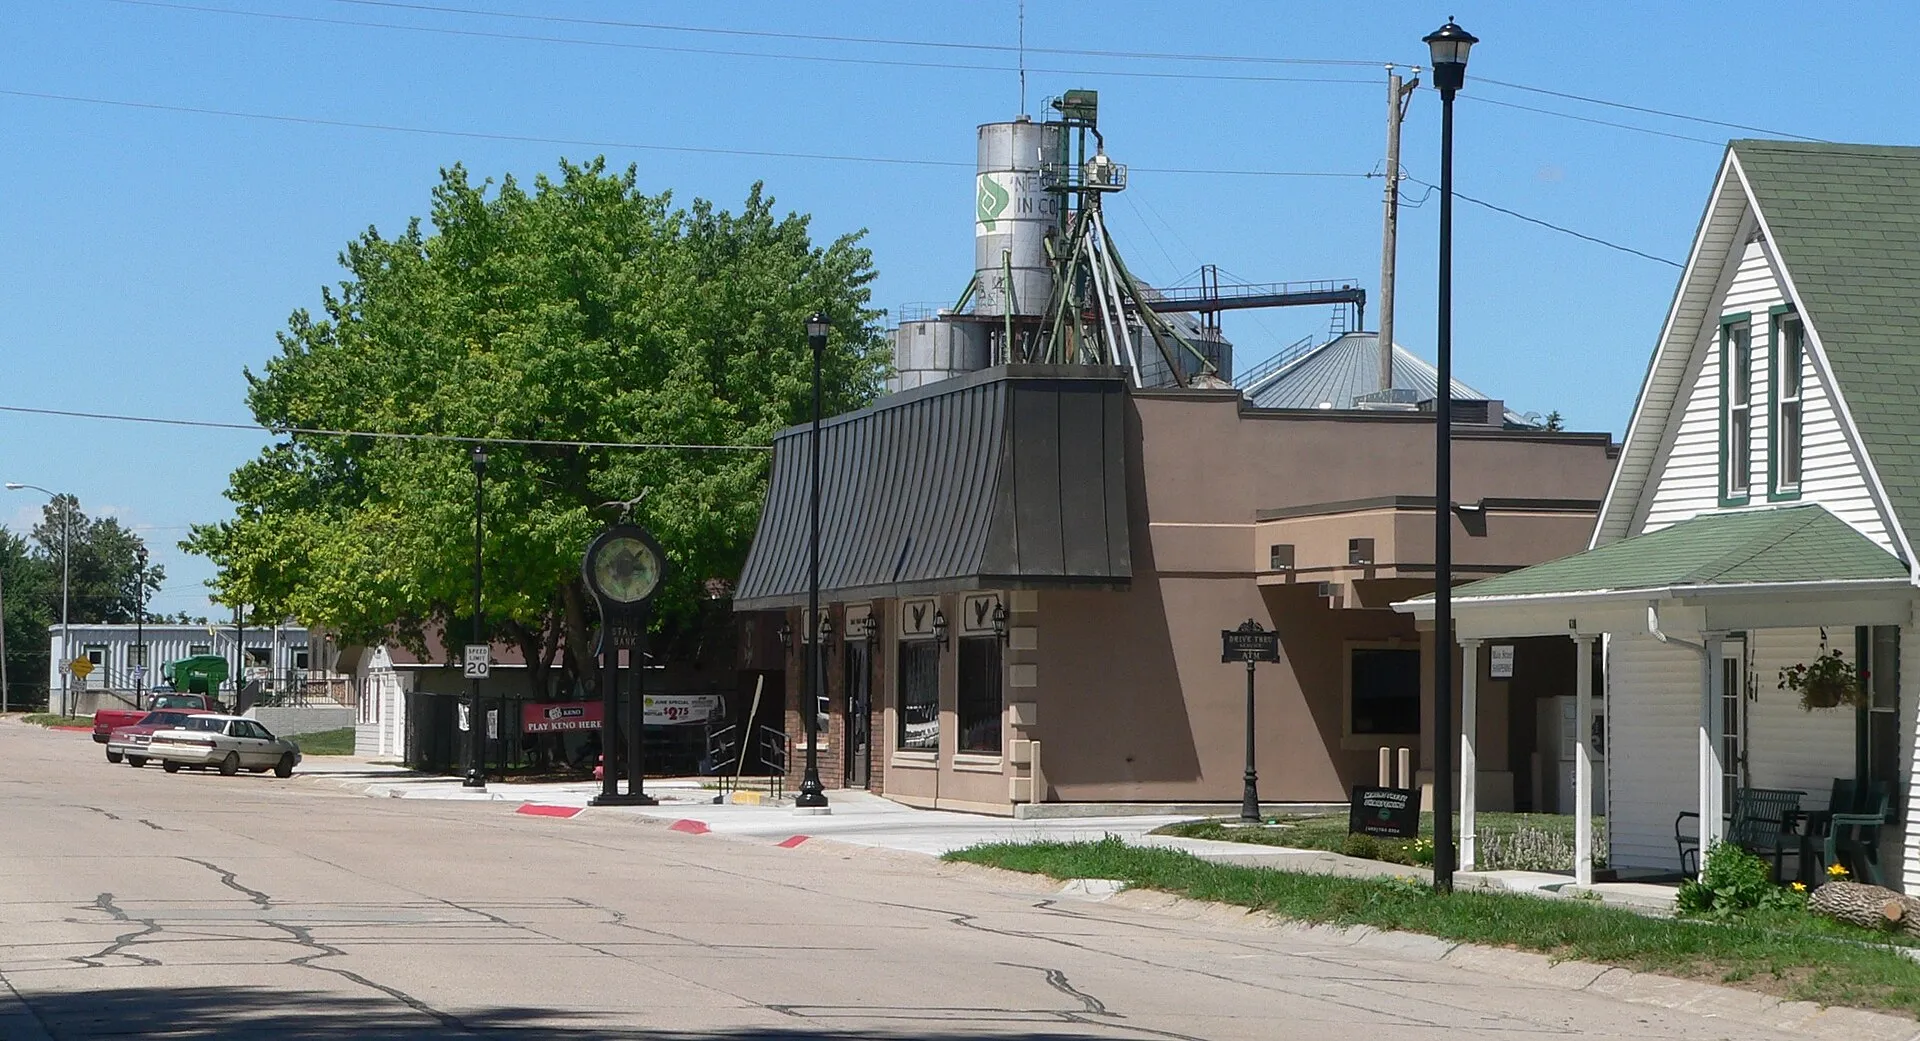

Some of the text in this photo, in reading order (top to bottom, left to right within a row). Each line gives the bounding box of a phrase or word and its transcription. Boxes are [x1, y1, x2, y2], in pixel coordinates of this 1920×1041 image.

[1017, 197, 1033, 213] IN
[613, 637, 636, 646] BANK
[1242, 651, 1261, 660] ATM
[467, 662, 488, 674] 20
[528, 720, 602, 731] PLAY KENO HERE
